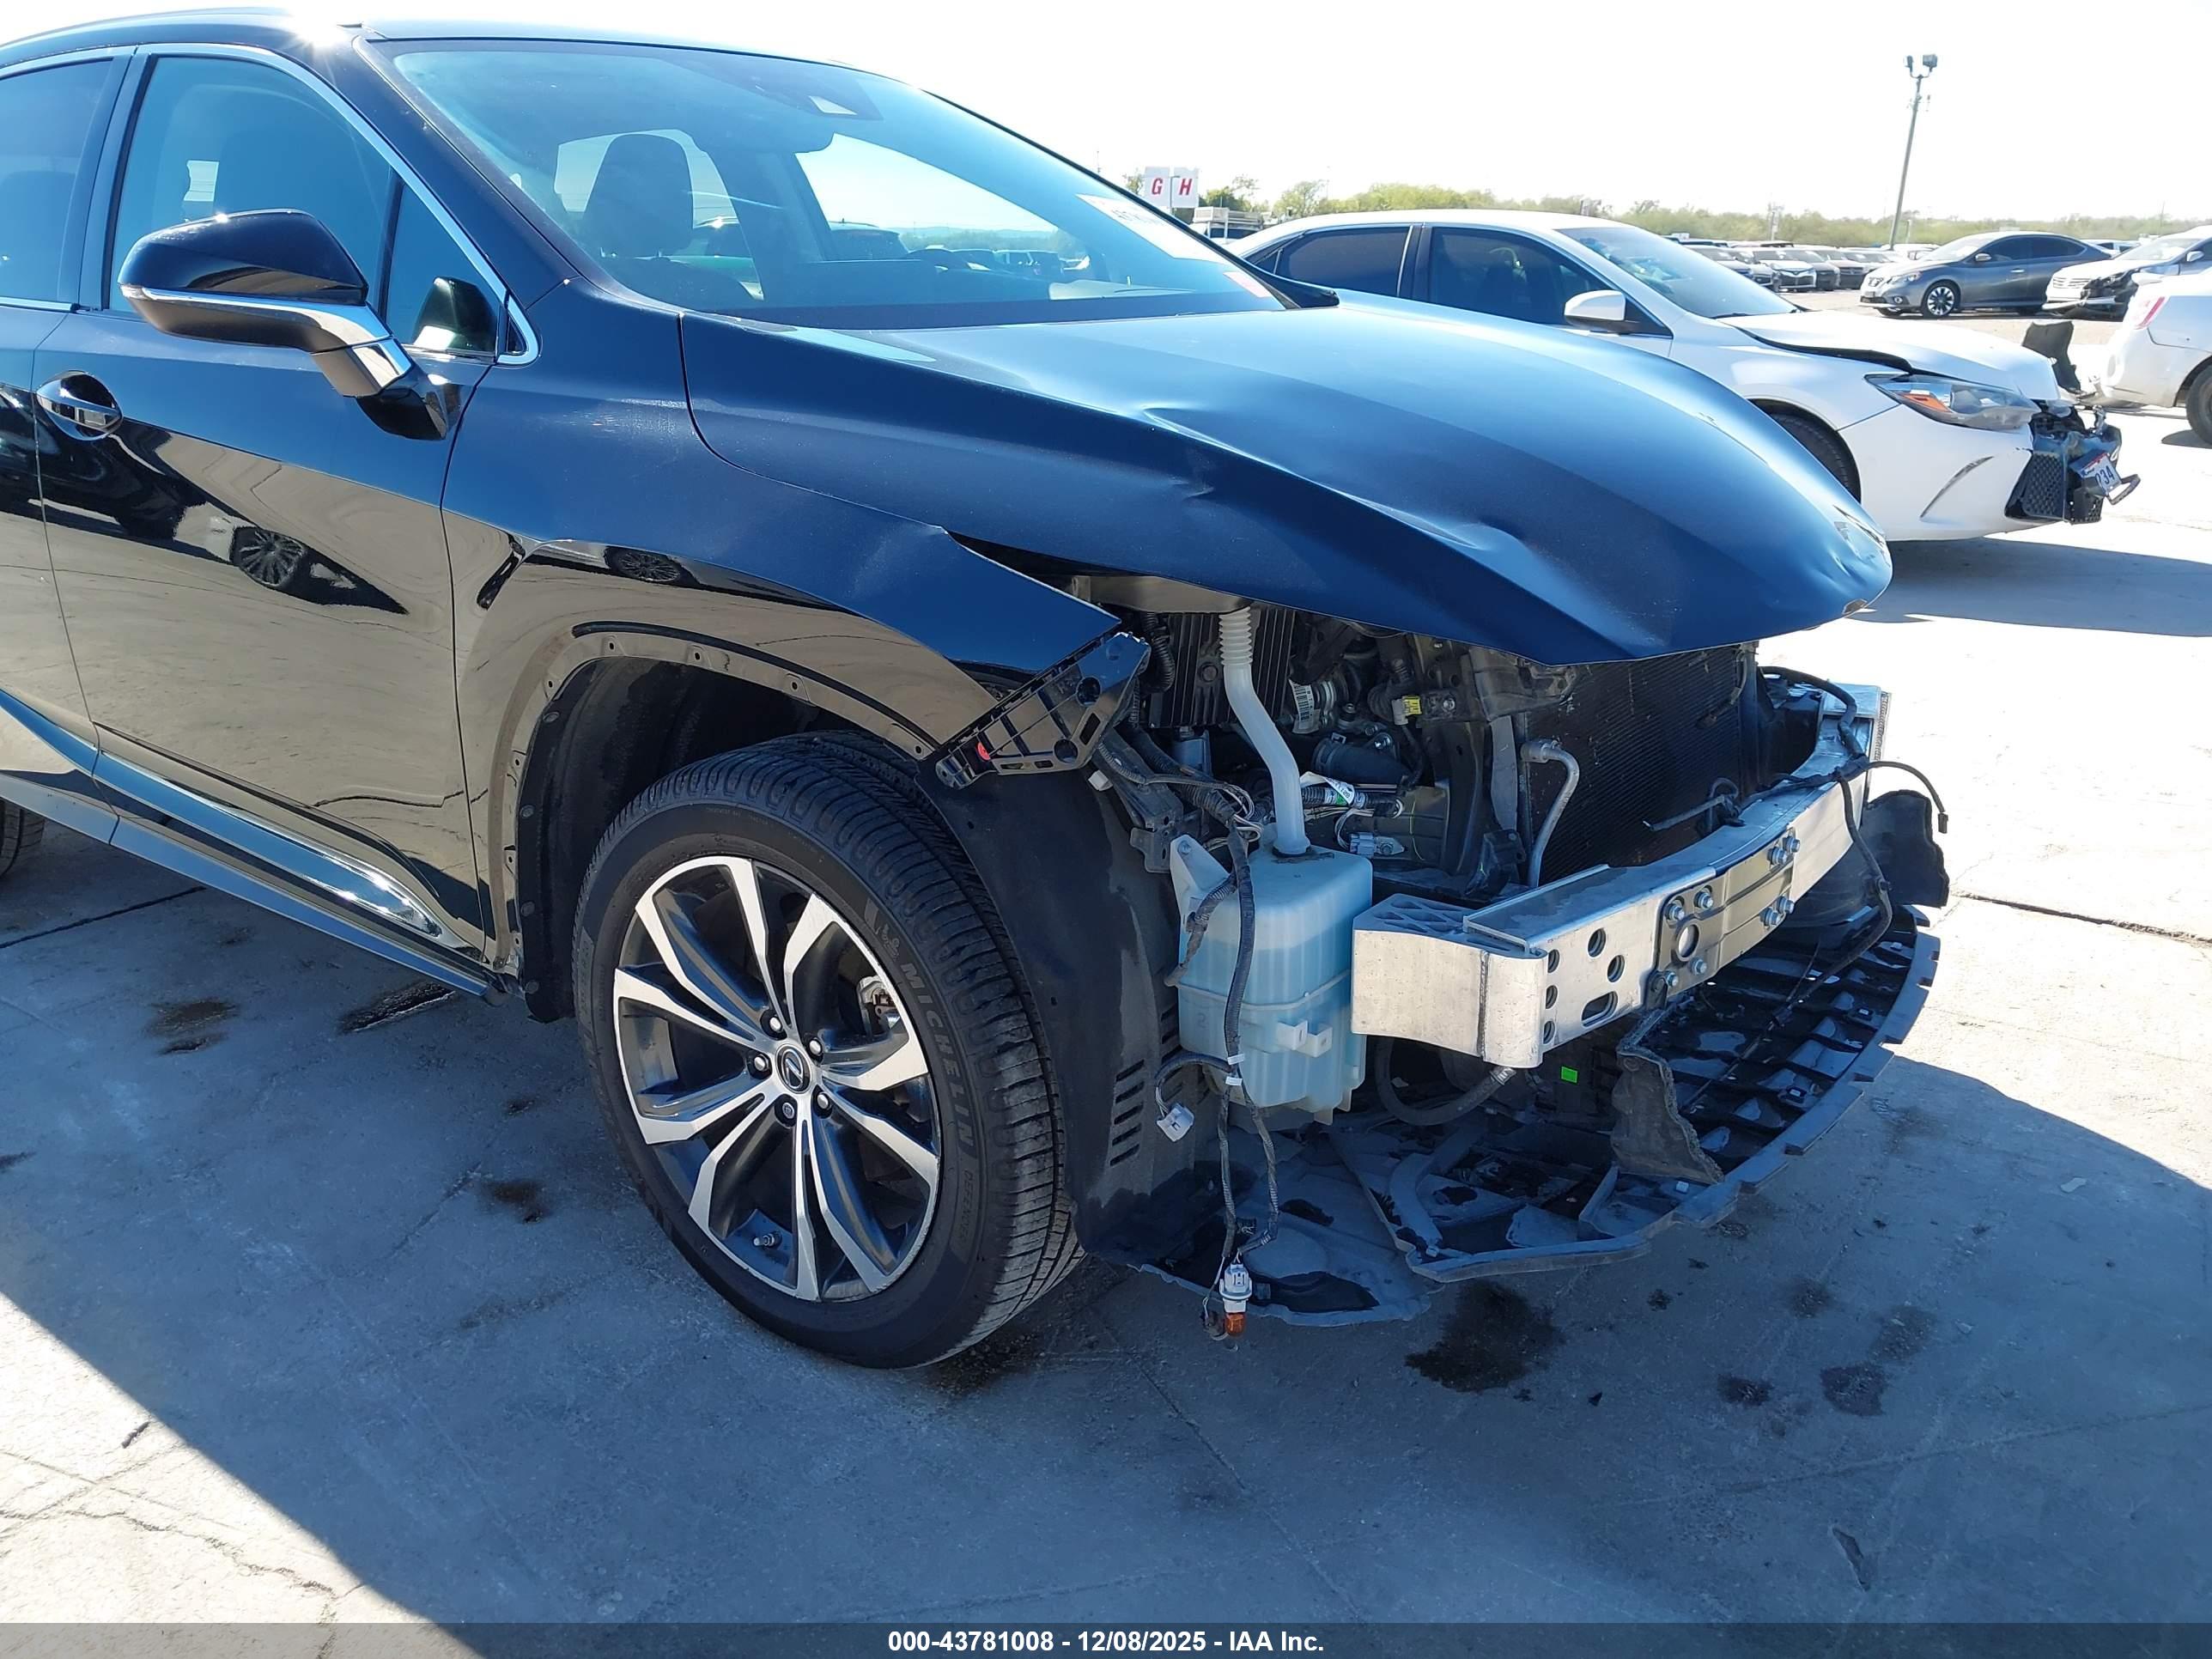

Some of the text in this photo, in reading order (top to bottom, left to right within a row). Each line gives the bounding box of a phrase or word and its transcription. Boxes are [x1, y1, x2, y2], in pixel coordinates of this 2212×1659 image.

[1152, 177, 1163, 195] G
[1179, 178, 1193, 196] H
[901, 963, 975, 1147] MICHELIN
